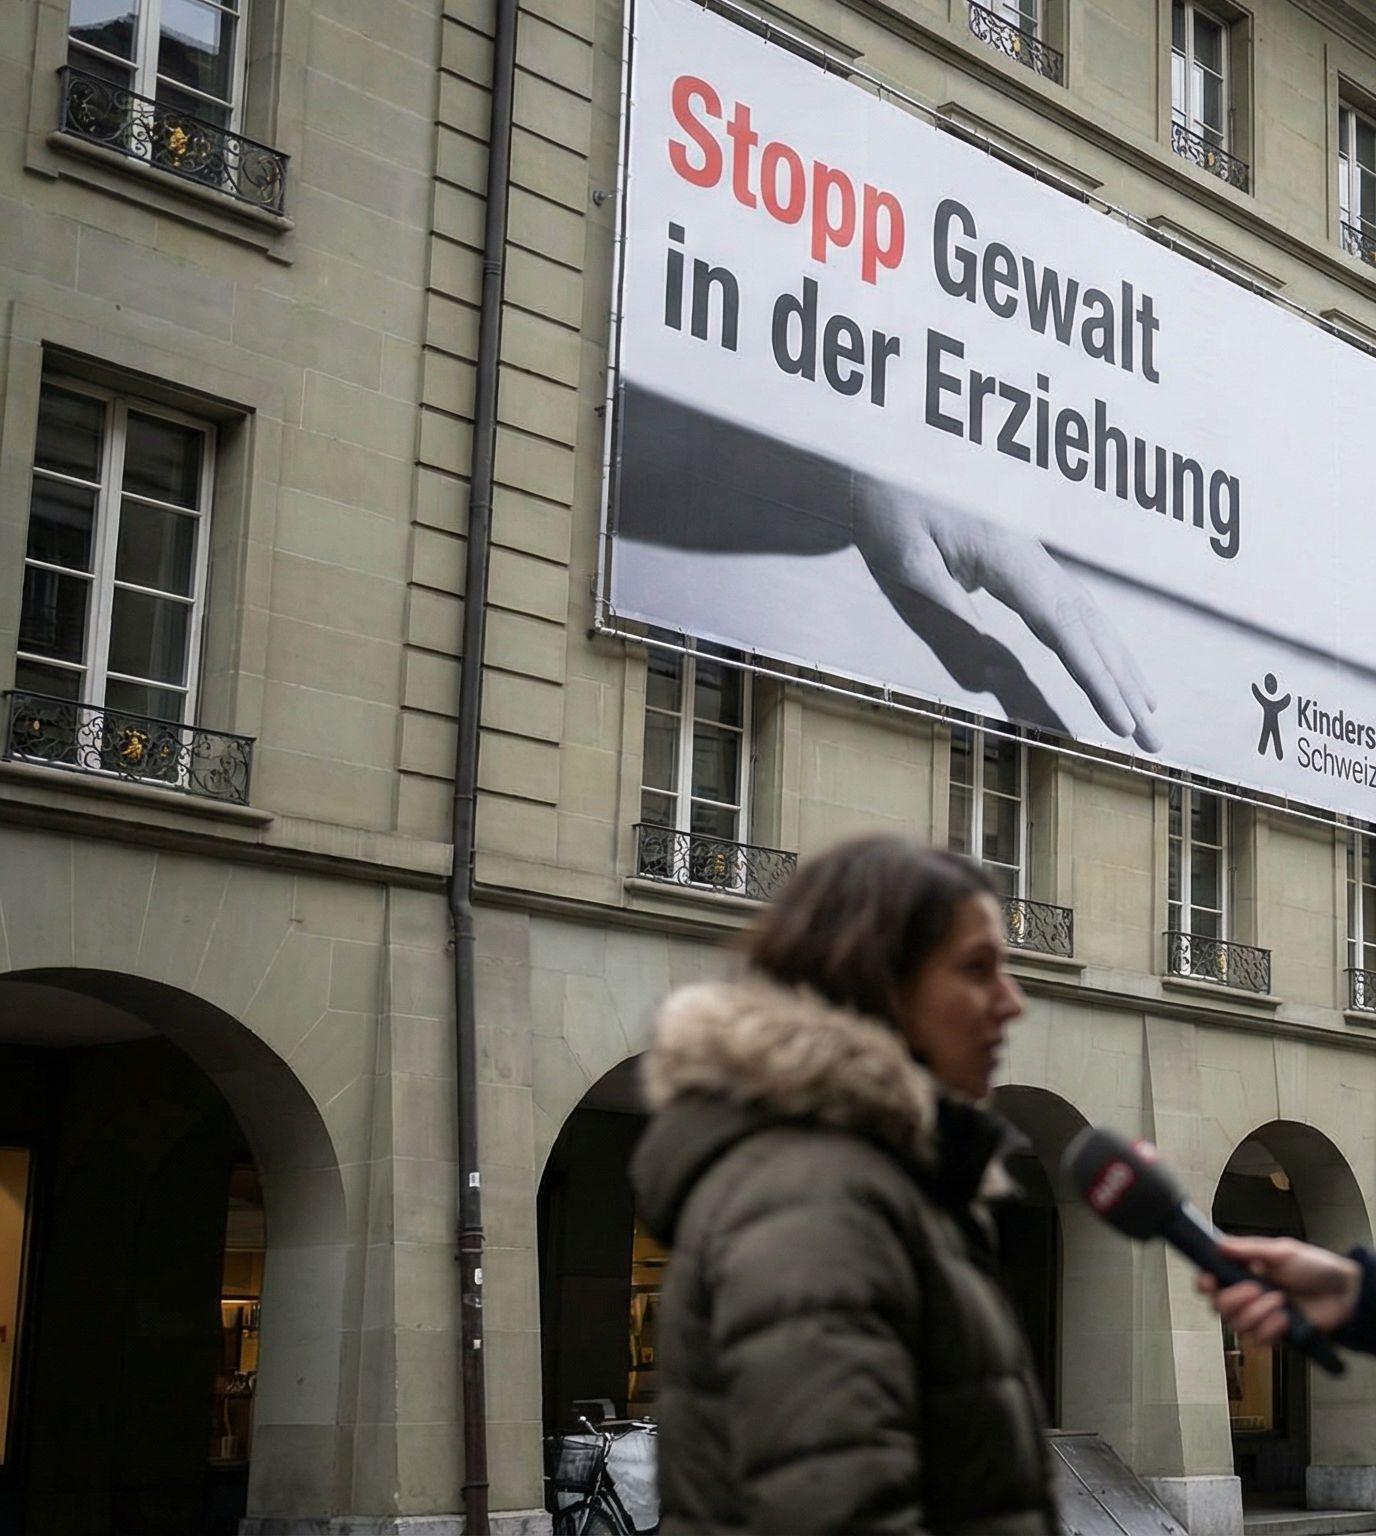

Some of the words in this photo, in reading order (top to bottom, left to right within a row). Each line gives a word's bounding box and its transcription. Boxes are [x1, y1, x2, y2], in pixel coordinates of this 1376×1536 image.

[664, 221, 739, 352] in
[771, 276, 900, 408] der
[925, 328, 1240, 560] Erziehung
[668, 75, 905, 285] Stopp
[933, 198, 1160, 384] Gewalt
